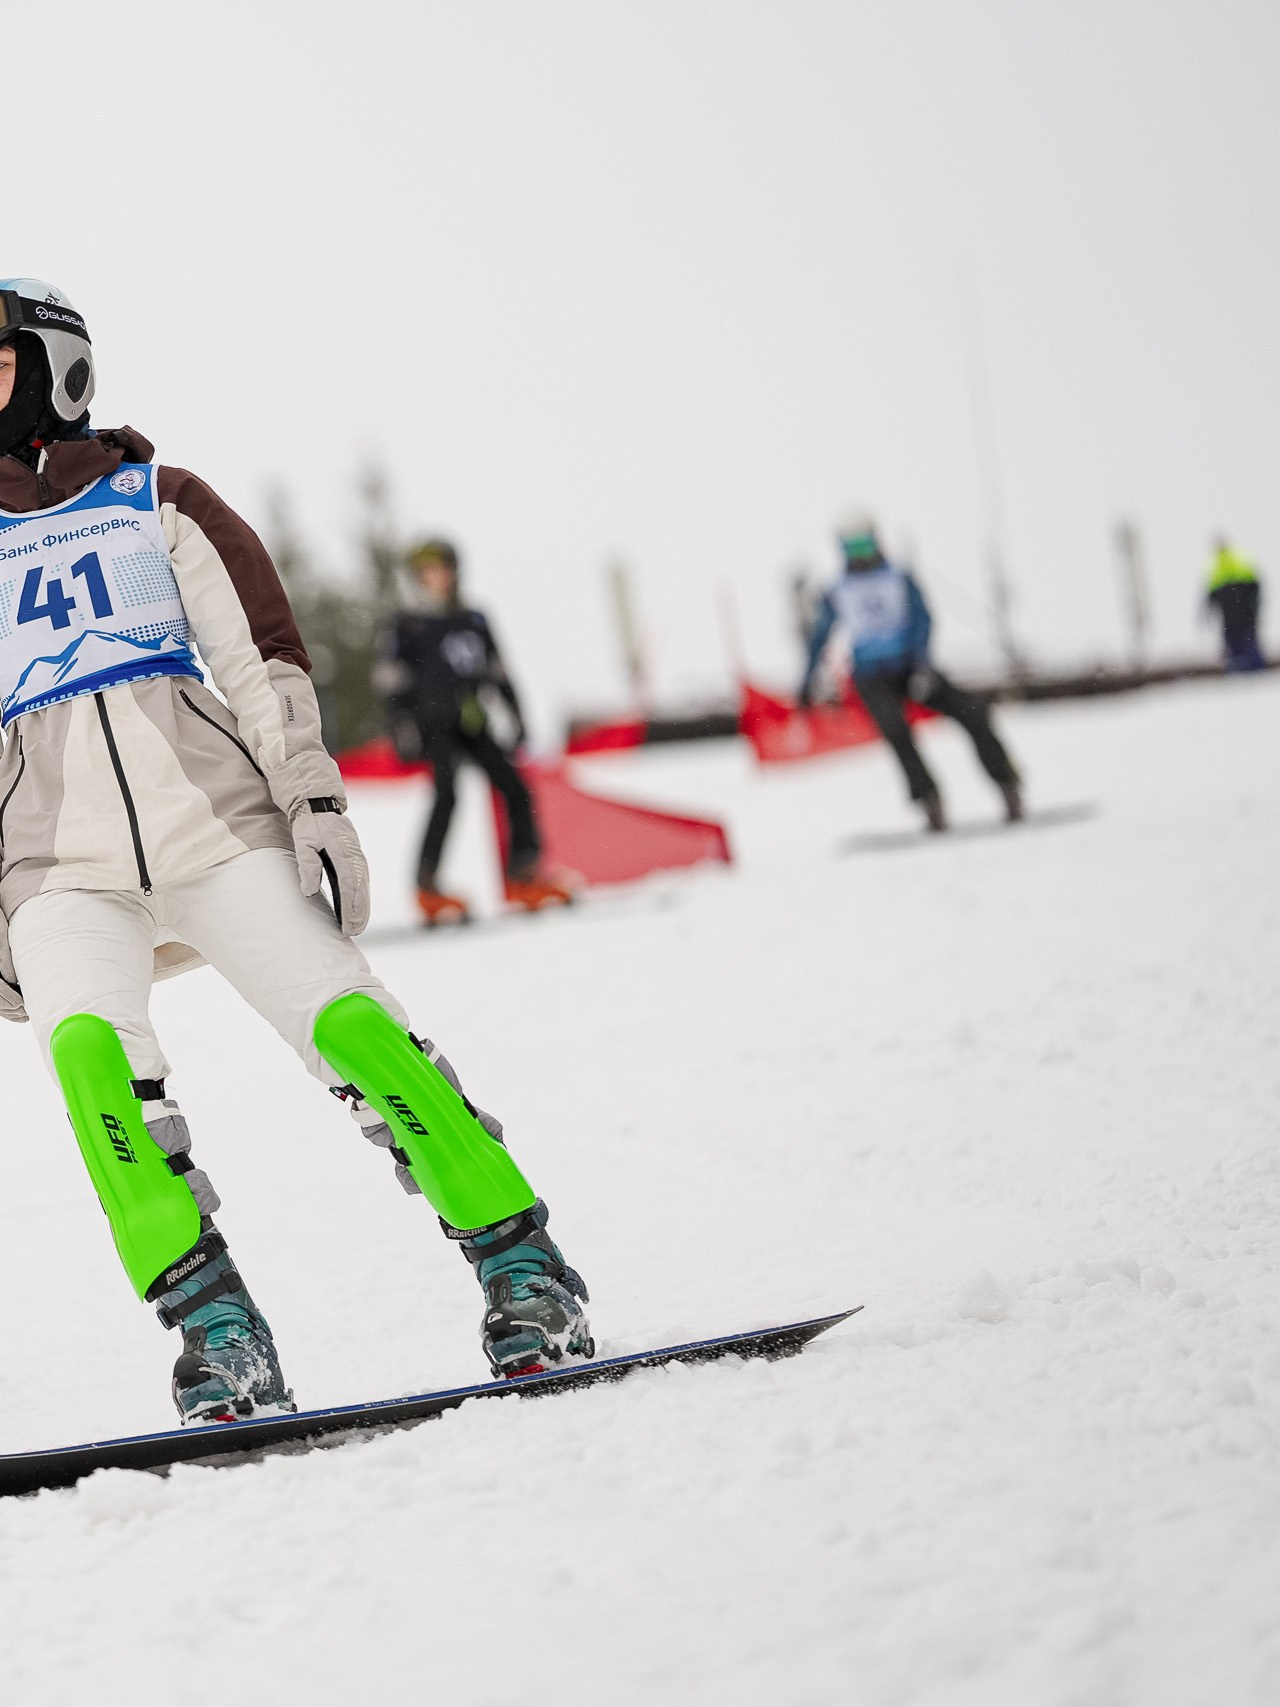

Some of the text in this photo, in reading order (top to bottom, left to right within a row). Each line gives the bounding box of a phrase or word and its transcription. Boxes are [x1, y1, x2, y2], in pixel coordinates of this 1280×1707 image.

[42, 518, 141, 548] Финсервис
[17, 551, 114, 631] 41
[385, 1095, 430, 1135] UFO
[100, 1113, 133, 1163] UFO
